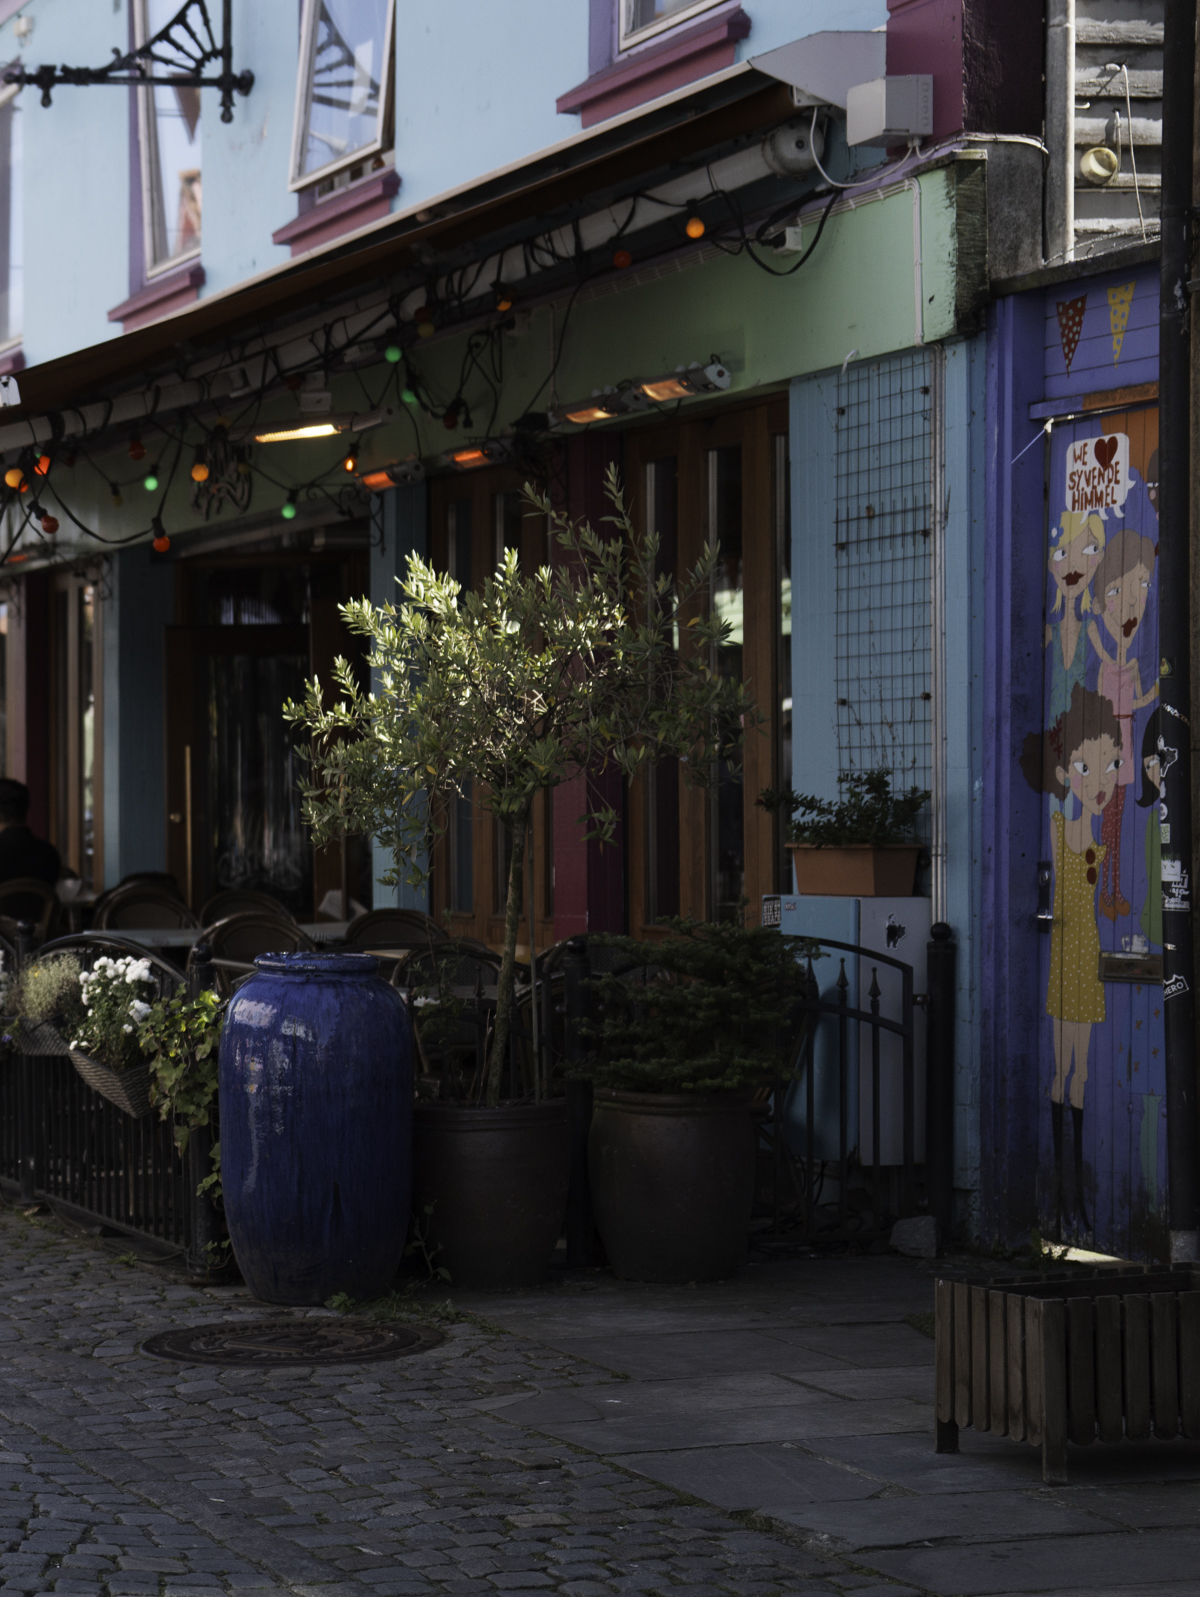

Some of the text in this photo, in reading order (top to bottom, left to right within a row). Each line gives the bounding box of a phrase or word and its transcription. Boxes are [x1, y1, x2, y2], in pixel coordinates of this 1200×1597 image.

[1073, 442, 1088, 466] WE
[1068, 461, 1120, 491] SYVENDE
[1163, 981, 1184, 997] HERO
